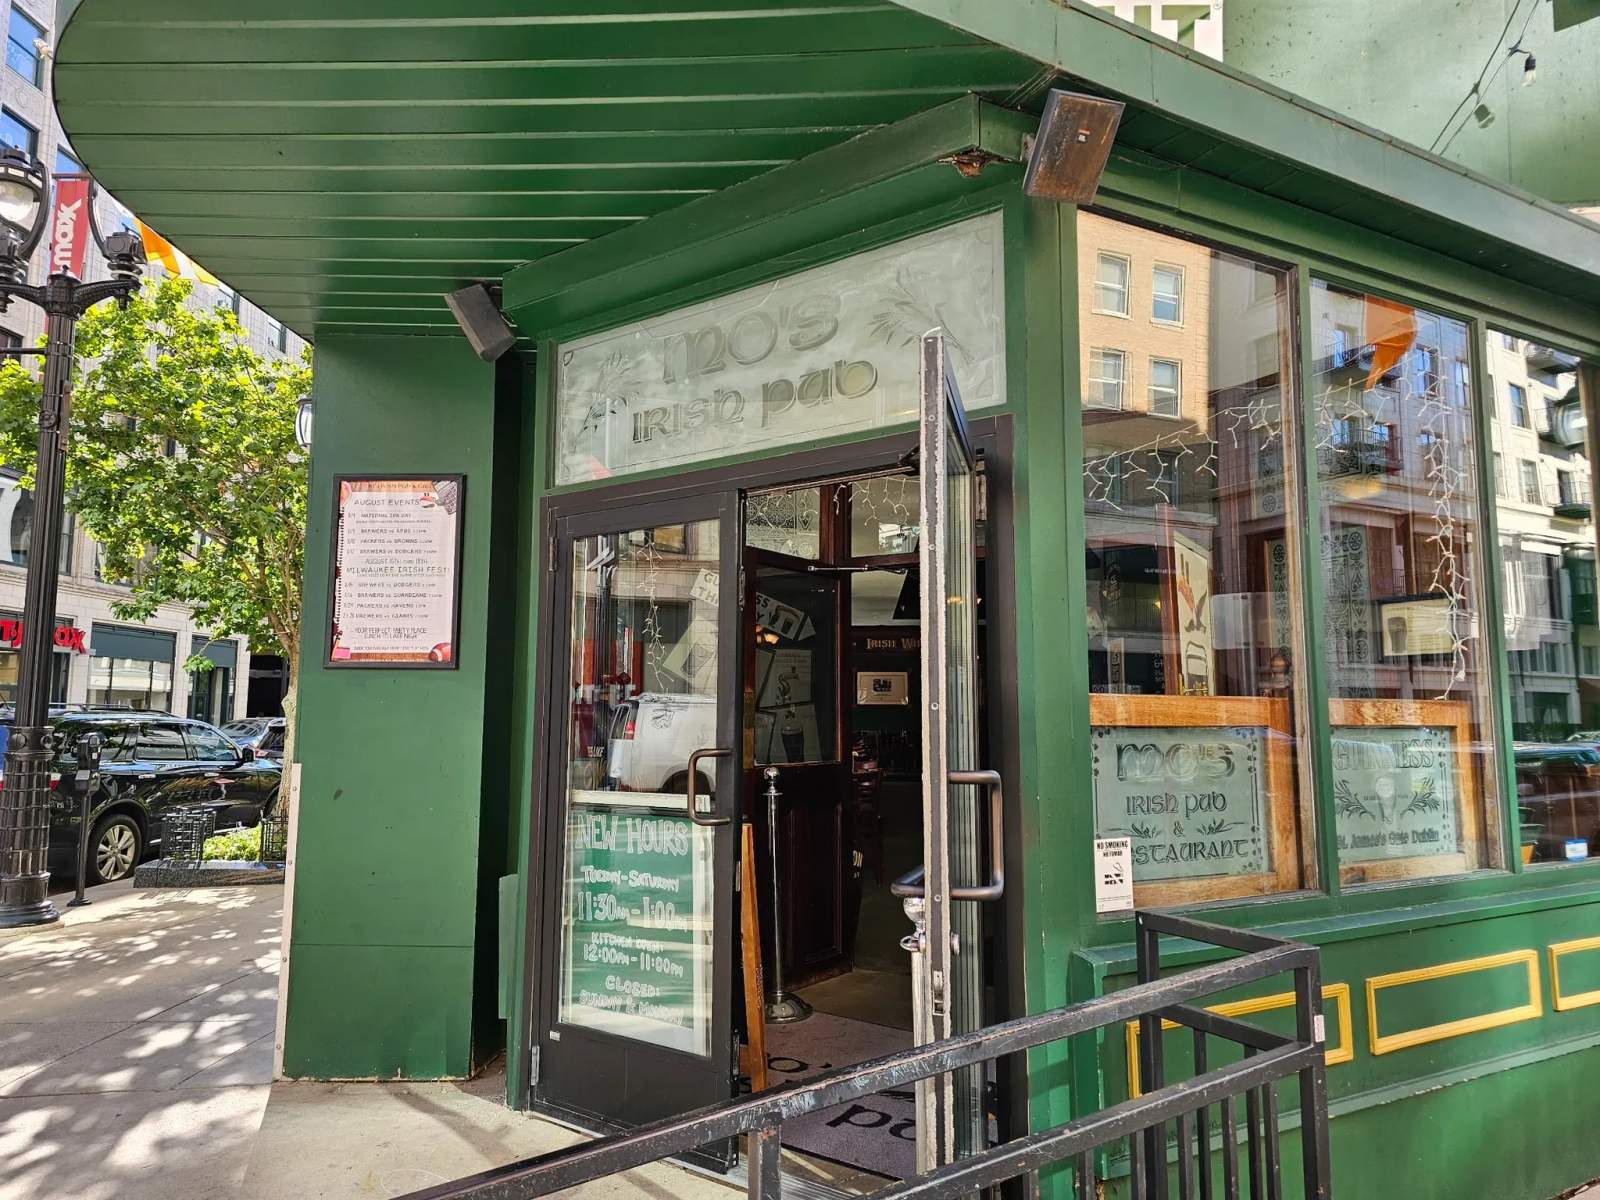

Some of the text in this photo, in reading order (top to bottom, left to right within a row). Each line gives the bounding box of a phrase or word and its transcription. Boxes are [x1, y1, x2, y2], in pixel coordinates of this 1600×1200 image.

[354, 498, 420, 506] AUGUST EVENTS
[575, 813, 689, 856] NEW HOURS
[1172, 820, 1186, 838] &
[1097, 840, 1128, 850] NO SMOKING
[1131, 839, 1250, 866] STAURANT
